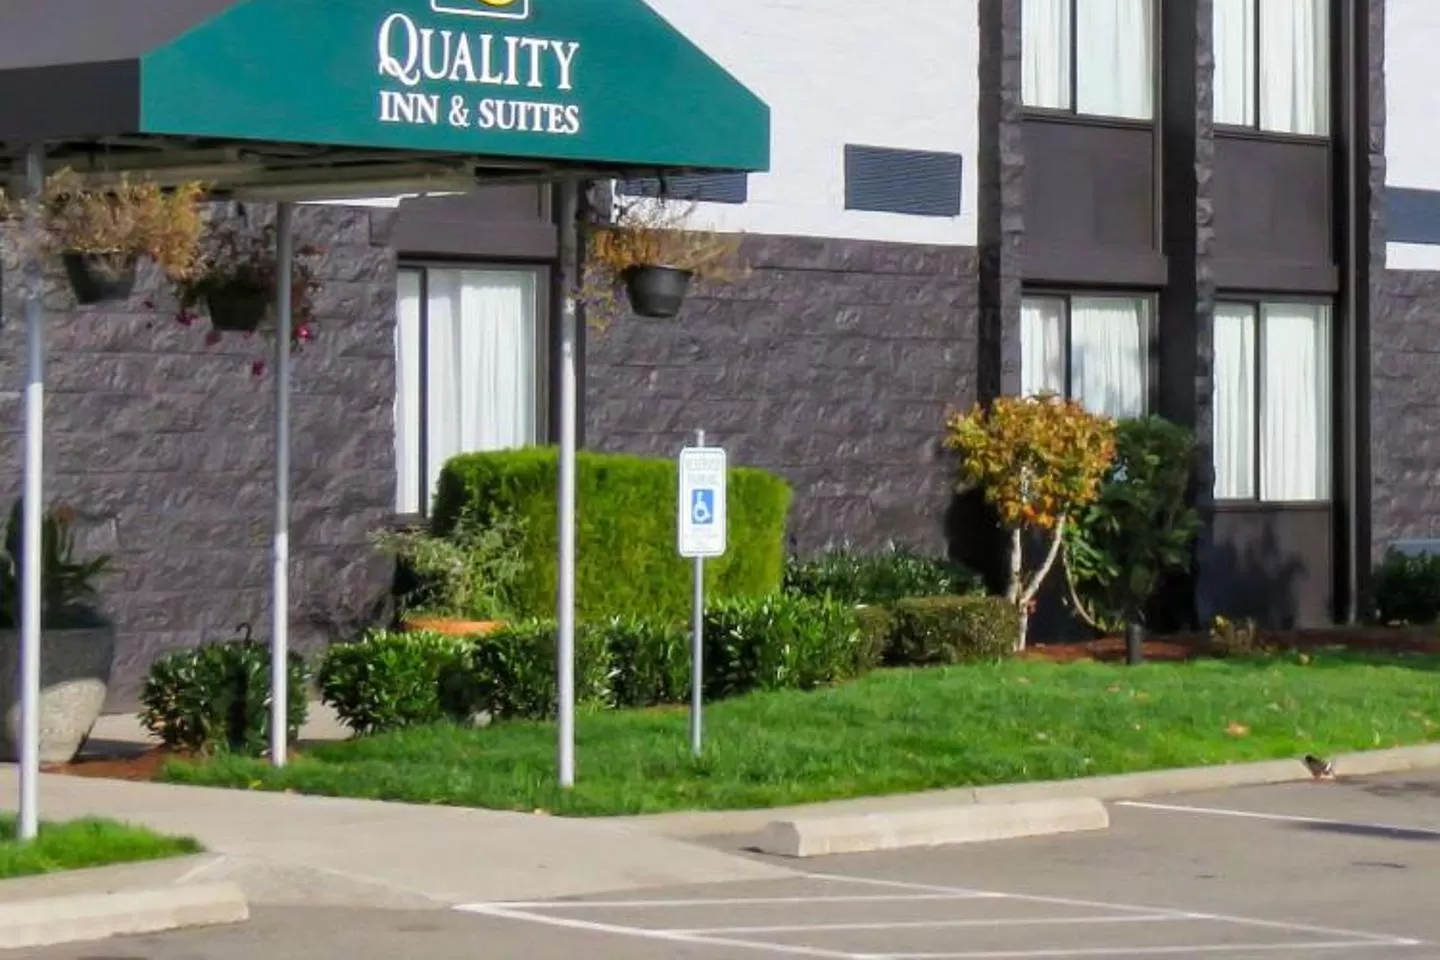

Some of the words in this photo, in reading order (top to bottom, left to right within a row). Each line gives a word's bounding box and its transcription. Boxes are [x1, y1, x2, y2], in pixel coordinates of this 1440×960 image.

[378, 12, 580, 91] QUALITY
[379, 90, 440, 124] INN
[448, 95, 471, 128] &
[478, 98, 580, 134] SUITES
